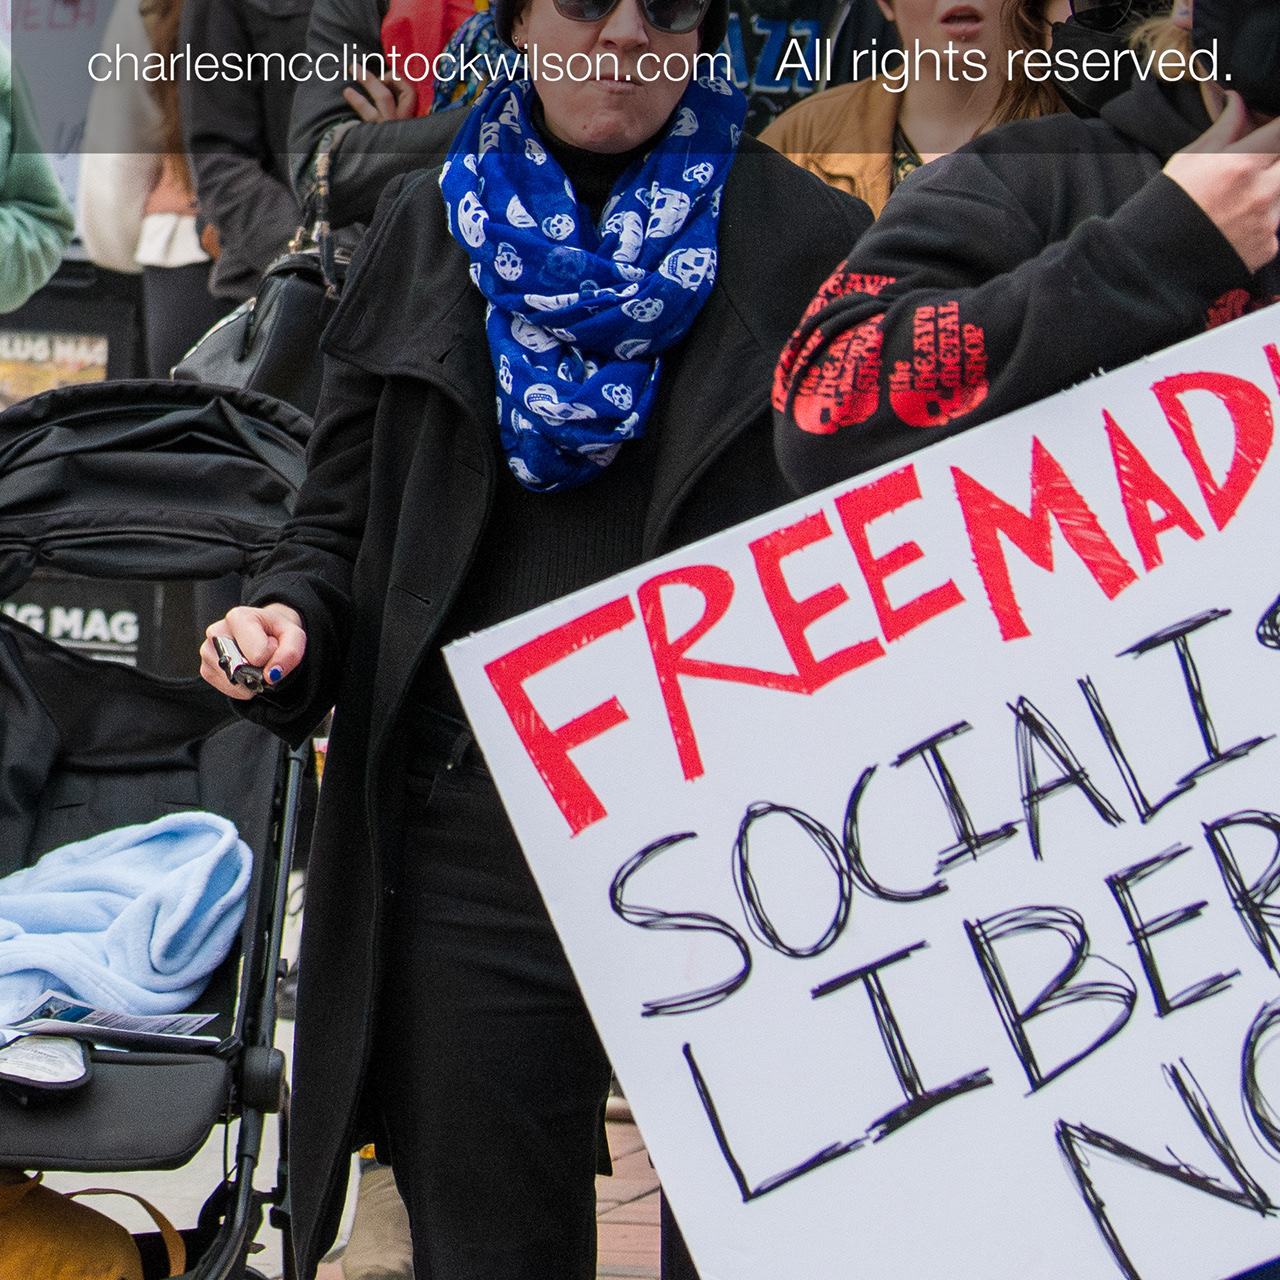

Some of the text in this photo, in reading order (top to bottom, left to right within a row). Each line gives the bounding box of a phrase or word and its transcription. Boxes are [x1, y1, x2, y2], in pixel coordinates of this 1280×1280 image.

[49, 605, 139, 643] MAG
[951, 343, 1280, 641] MAD
[609, 586, 1280, 1017] SOCIALI
